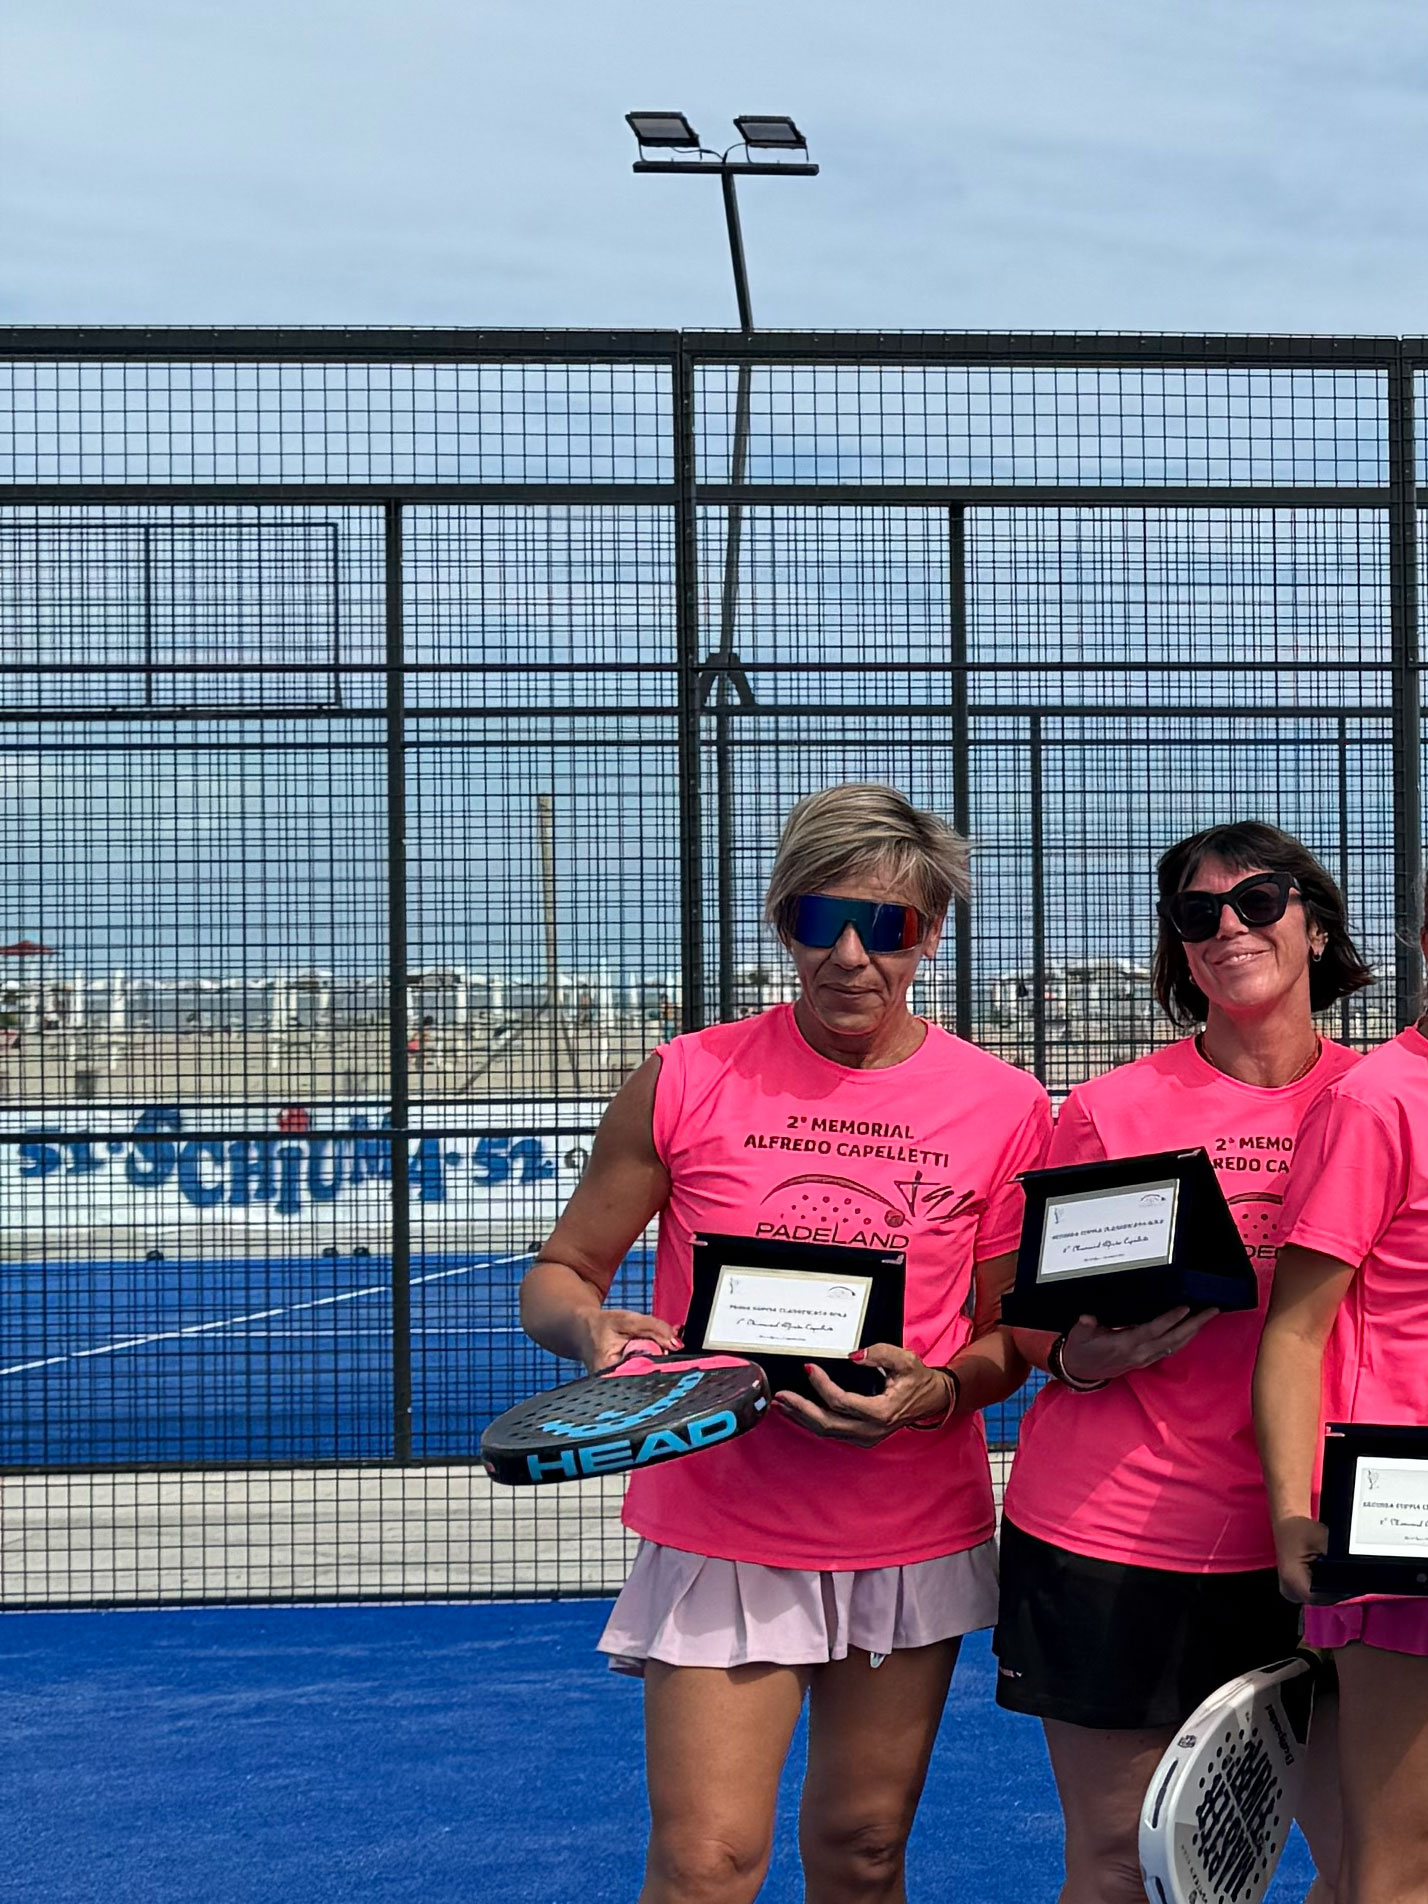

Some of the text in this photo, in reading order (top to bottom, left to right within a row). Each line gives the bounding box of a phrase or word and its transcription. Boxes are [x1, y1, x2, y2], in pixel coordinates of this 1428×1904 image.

[811, 1117, 914, 1140] MEMORIAL
[744, 1134, 949, 1168] ALFREDO CAPELLETTI
[1239, 1136, 1293, 1152] MEMO
[1213, 1157, 1261, 1172] REDO
[526, 1410, 738, 1482] HEAD
